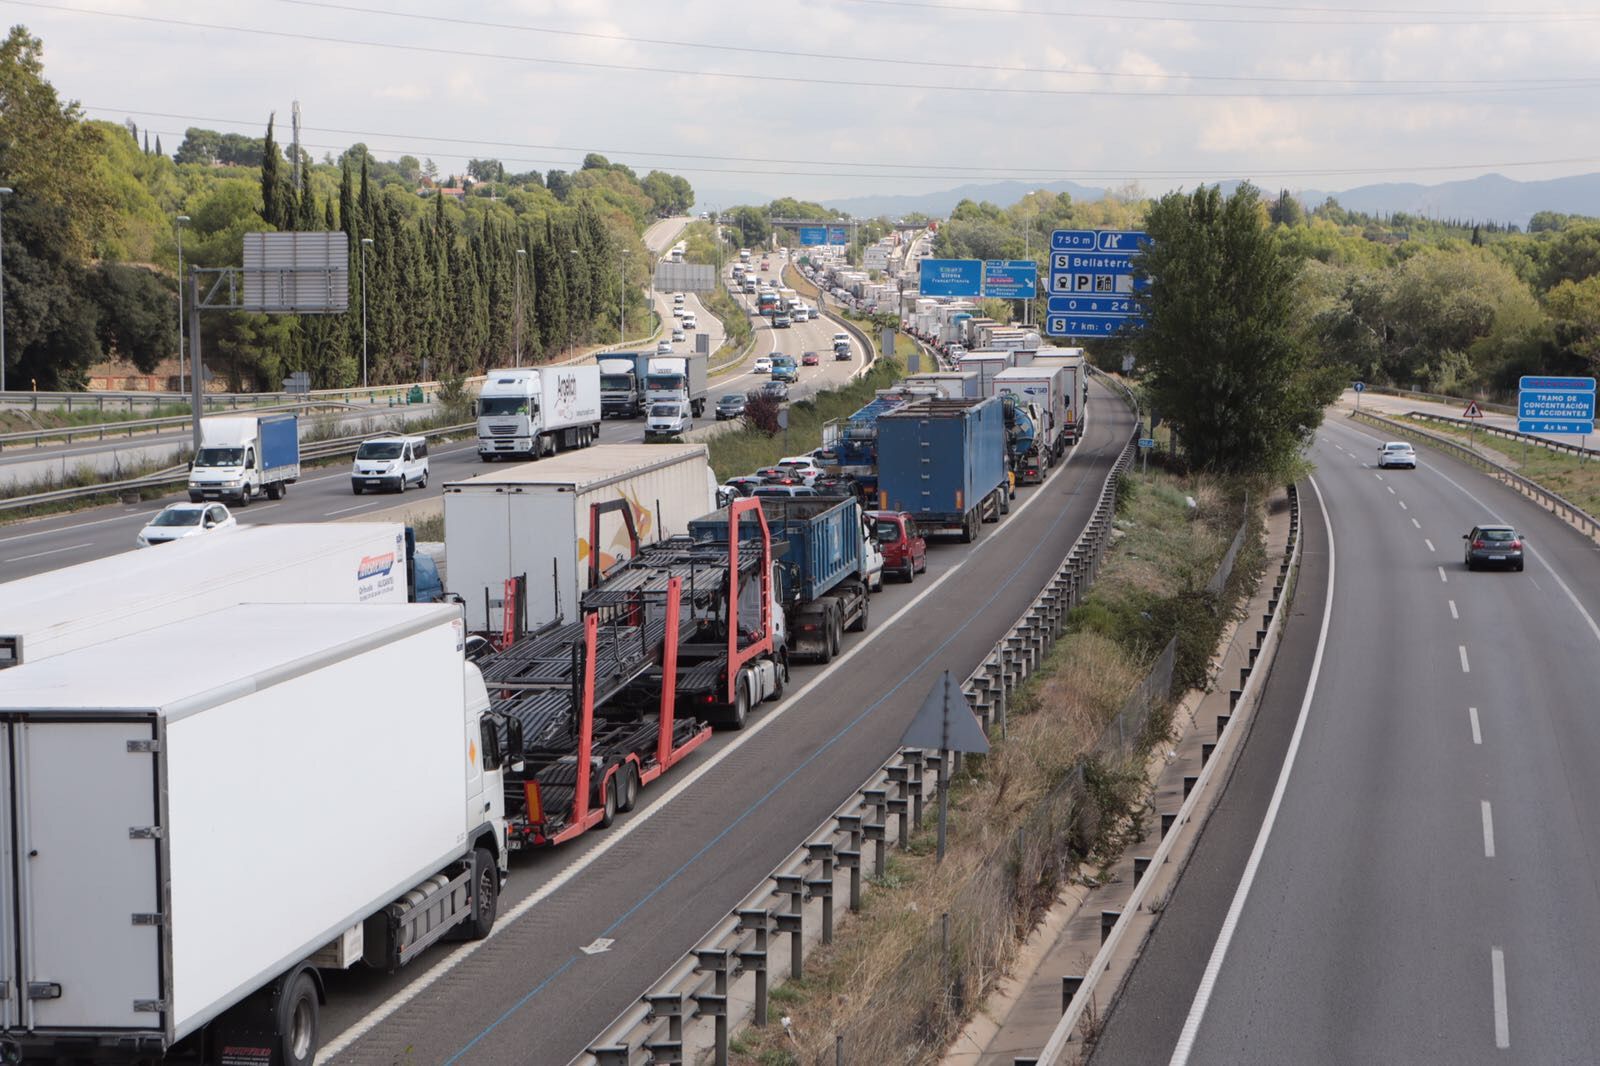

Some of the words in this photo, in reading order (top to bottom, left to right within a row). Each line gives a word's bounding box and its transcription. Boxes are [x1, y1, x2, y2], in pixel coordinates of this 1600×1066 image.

[1057, 236, 1079, 244] 750
[1058, 257, 1066, 267] S
[1073, 257, 1134, 268] Bellaterra
[1077, 276, 1089, 290] P
[1069, 300, 1077, 309] 0
[1091, 302, 1097, 310] a
[1111, 302, 1128, 311] 24
[1055, 320, 1063, 330] S
[1070, 322, 1076, 330] 7
[1081, 322, 1098, 331] km:
[1105, 322, 1112, 331] 0
[1539, 409, 1587, 417] ACCIDENTES
